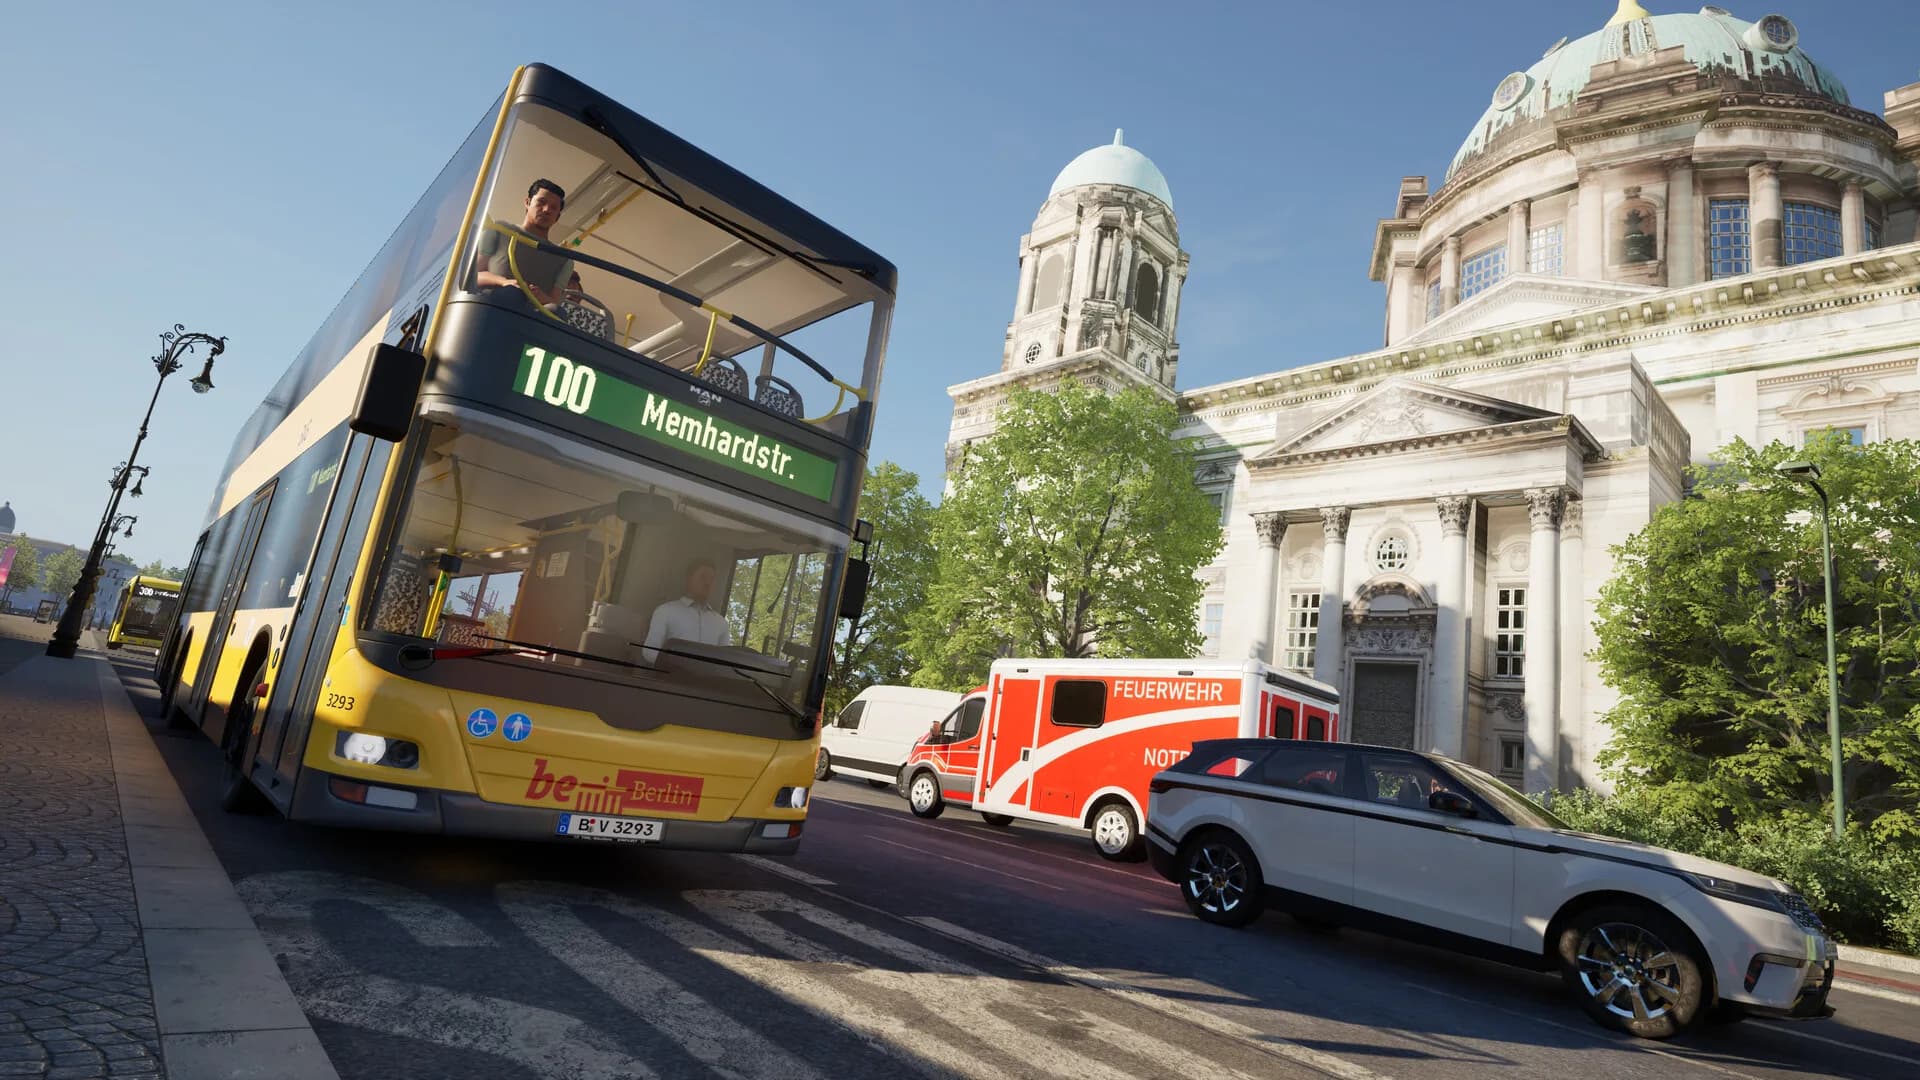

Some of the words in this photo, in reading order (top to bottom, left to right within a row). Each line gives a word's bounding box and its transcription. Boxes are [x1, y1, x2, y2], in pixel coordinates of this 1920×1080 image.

[690, 384, 722, 403] MAN
[524, 346, 597, 415] 100
[641, 393, 796, 480] Memhardstr.
[139, 586, 154, 596] 300
[1113, 680, 1223, 702] FEUERWEHR
[326, 692, 355, 711] 3293
[632, 780, 693, 805] Berlin
[578, 818, 590, 831] B
[600, 819, 610, 833] V
[613, 821, 654, 837] 3293
